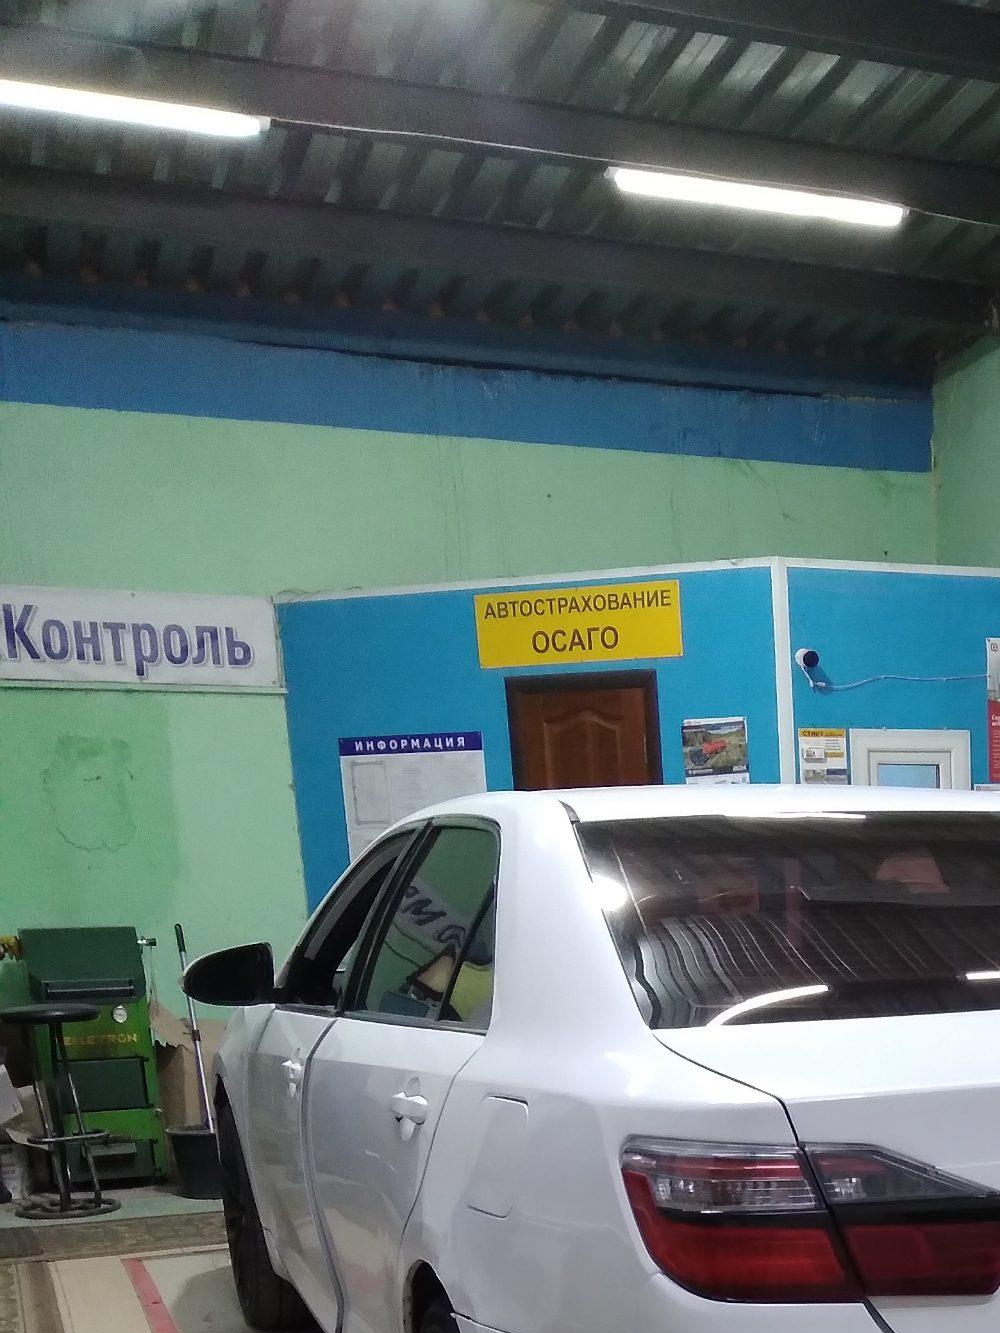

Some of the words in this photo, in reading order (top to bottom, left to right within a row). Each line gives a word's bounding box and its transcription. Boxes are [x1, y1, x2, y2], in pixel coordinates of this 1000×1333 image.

[484, 589, 671, 619] АВТОСТРАХОВАНИЕ
[2, 603, 253, 677] Контроль
[531, 625, 619, 653] ОСАГО
[354, 736, 466, 752] ИНФОРМАЦИЯ
